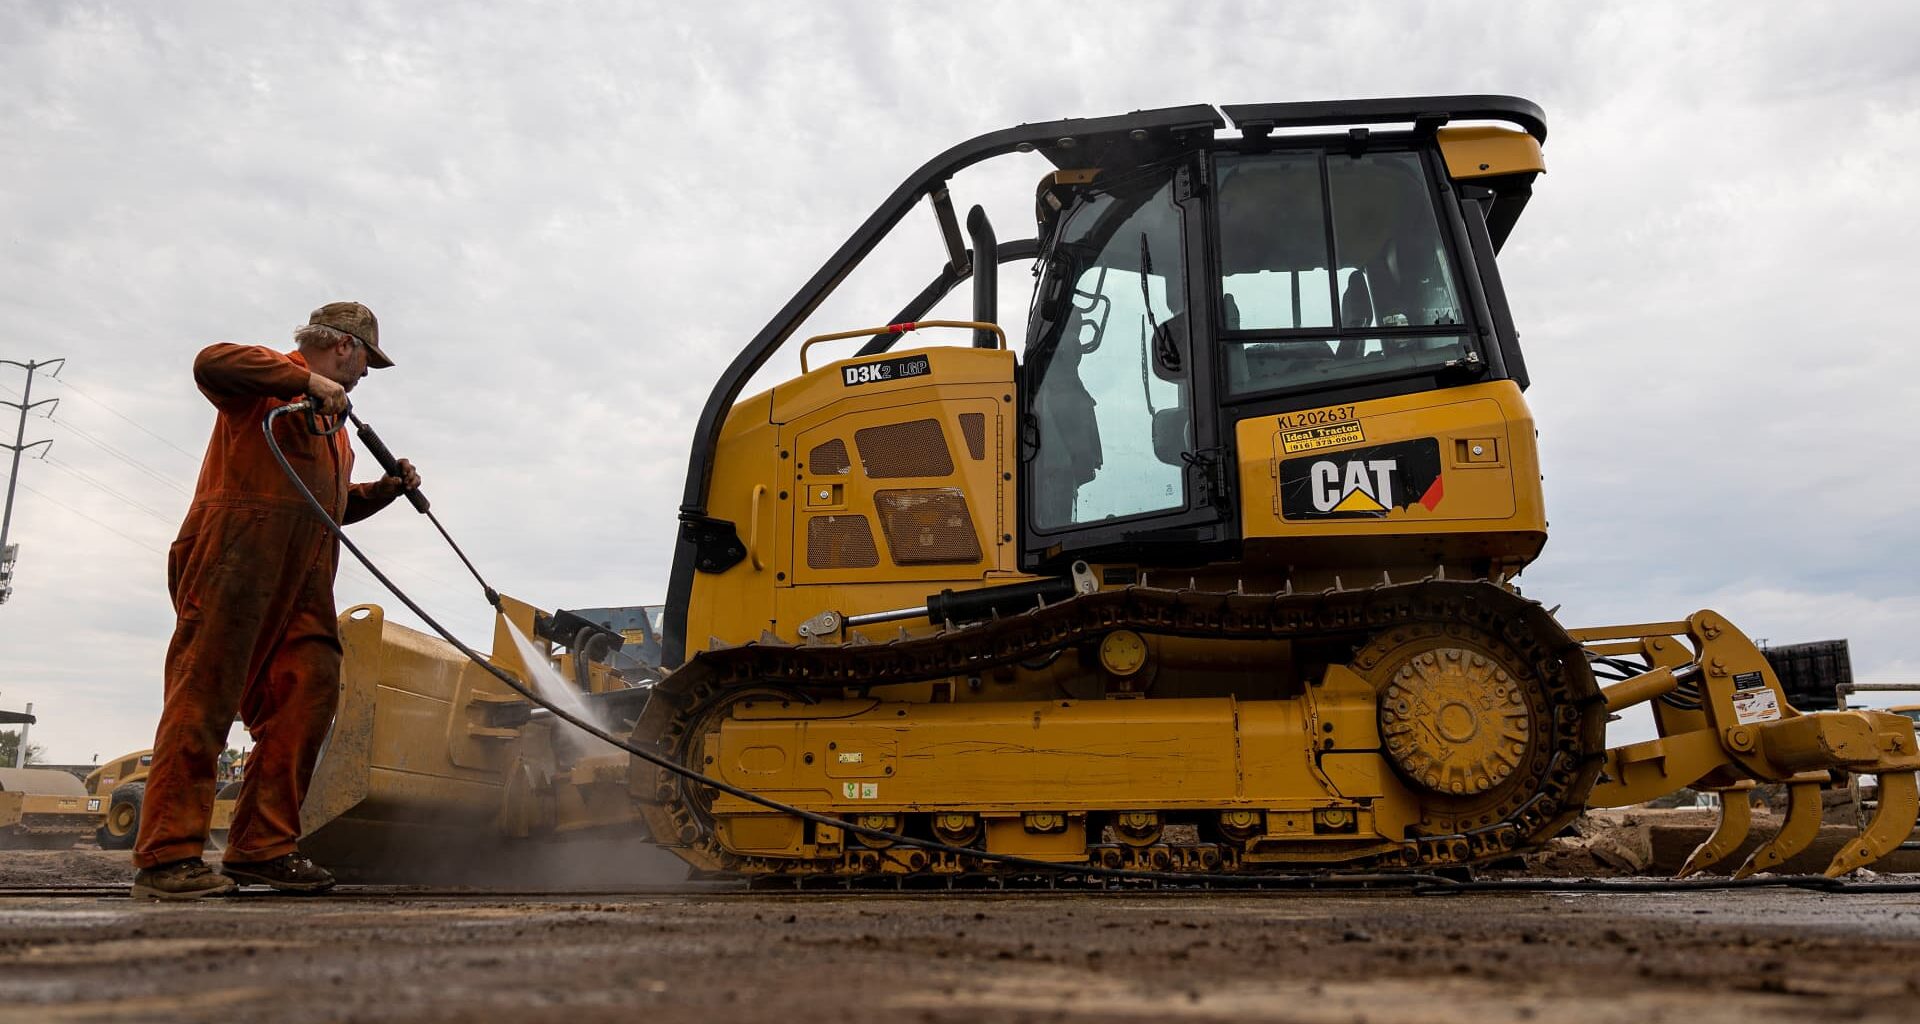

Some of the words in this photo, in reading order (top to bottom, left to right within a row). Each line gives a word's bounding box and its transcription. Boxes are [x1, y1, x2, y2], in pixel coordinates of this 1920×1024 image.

[900, 361, 927, 377] LGP
[1278, 406, 1355, 429] KL202637
[1286, 431, 1313, 442] Ideal
[1317, 424, 1358, 437] Tractor
[1316, 435, 1358, 447] 373-0900
[1311, 460, 1397, 512] CAT
[88, 800, 100, 811] CAT
